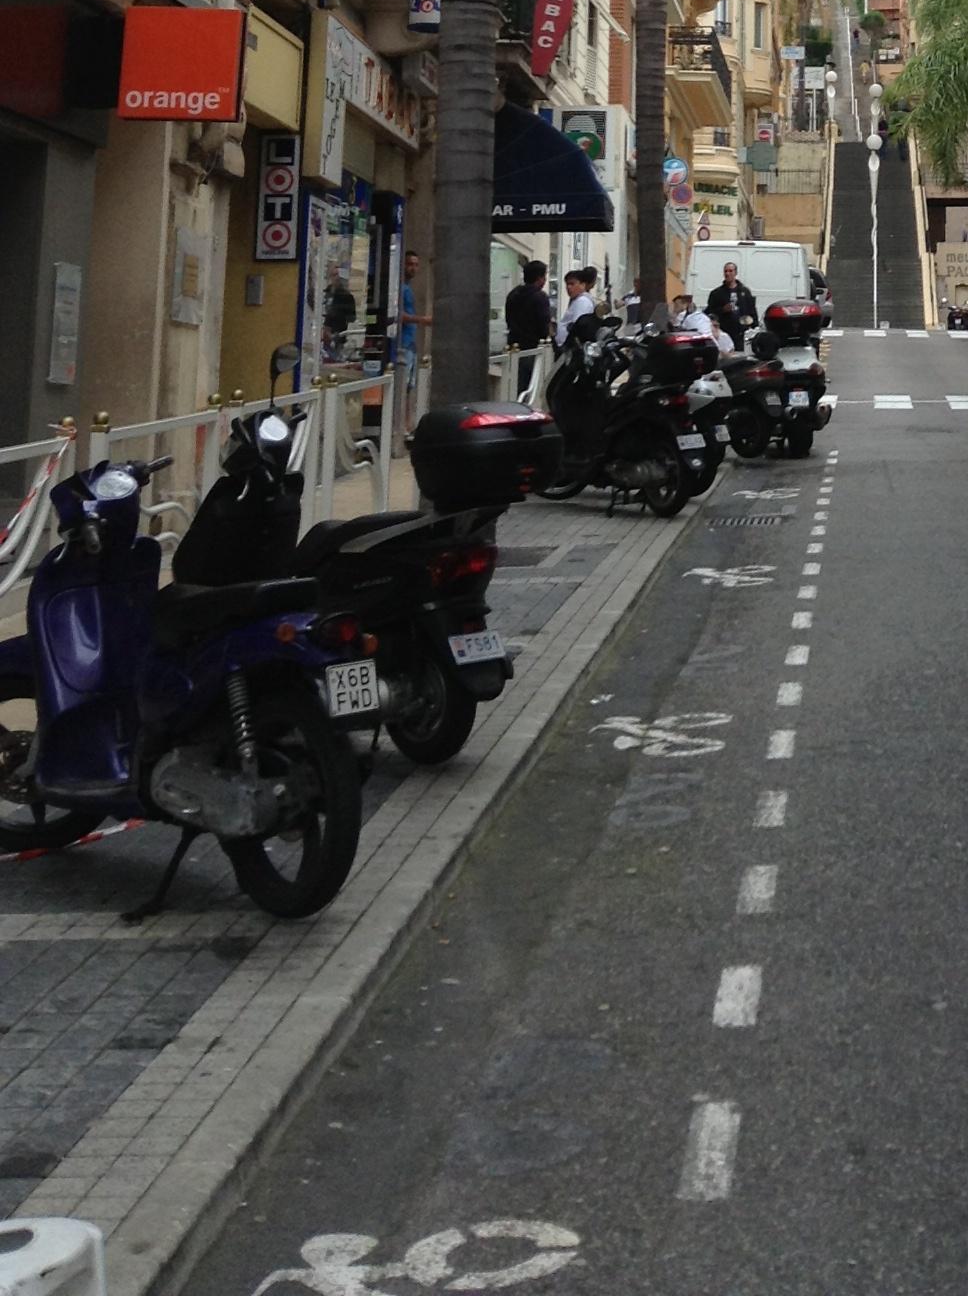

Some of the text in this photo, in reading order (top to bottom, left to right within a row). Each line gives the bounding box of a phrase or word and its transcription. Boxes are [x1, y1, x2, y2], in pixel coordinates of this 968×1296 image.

[125, 90, 221, 115] orange
[262, 138, 296, 250] LOTO
[532, 203, 567, 215] PMU
[335, 666, 370, 689] X6B
[336, 687, 373, 711] FWD
